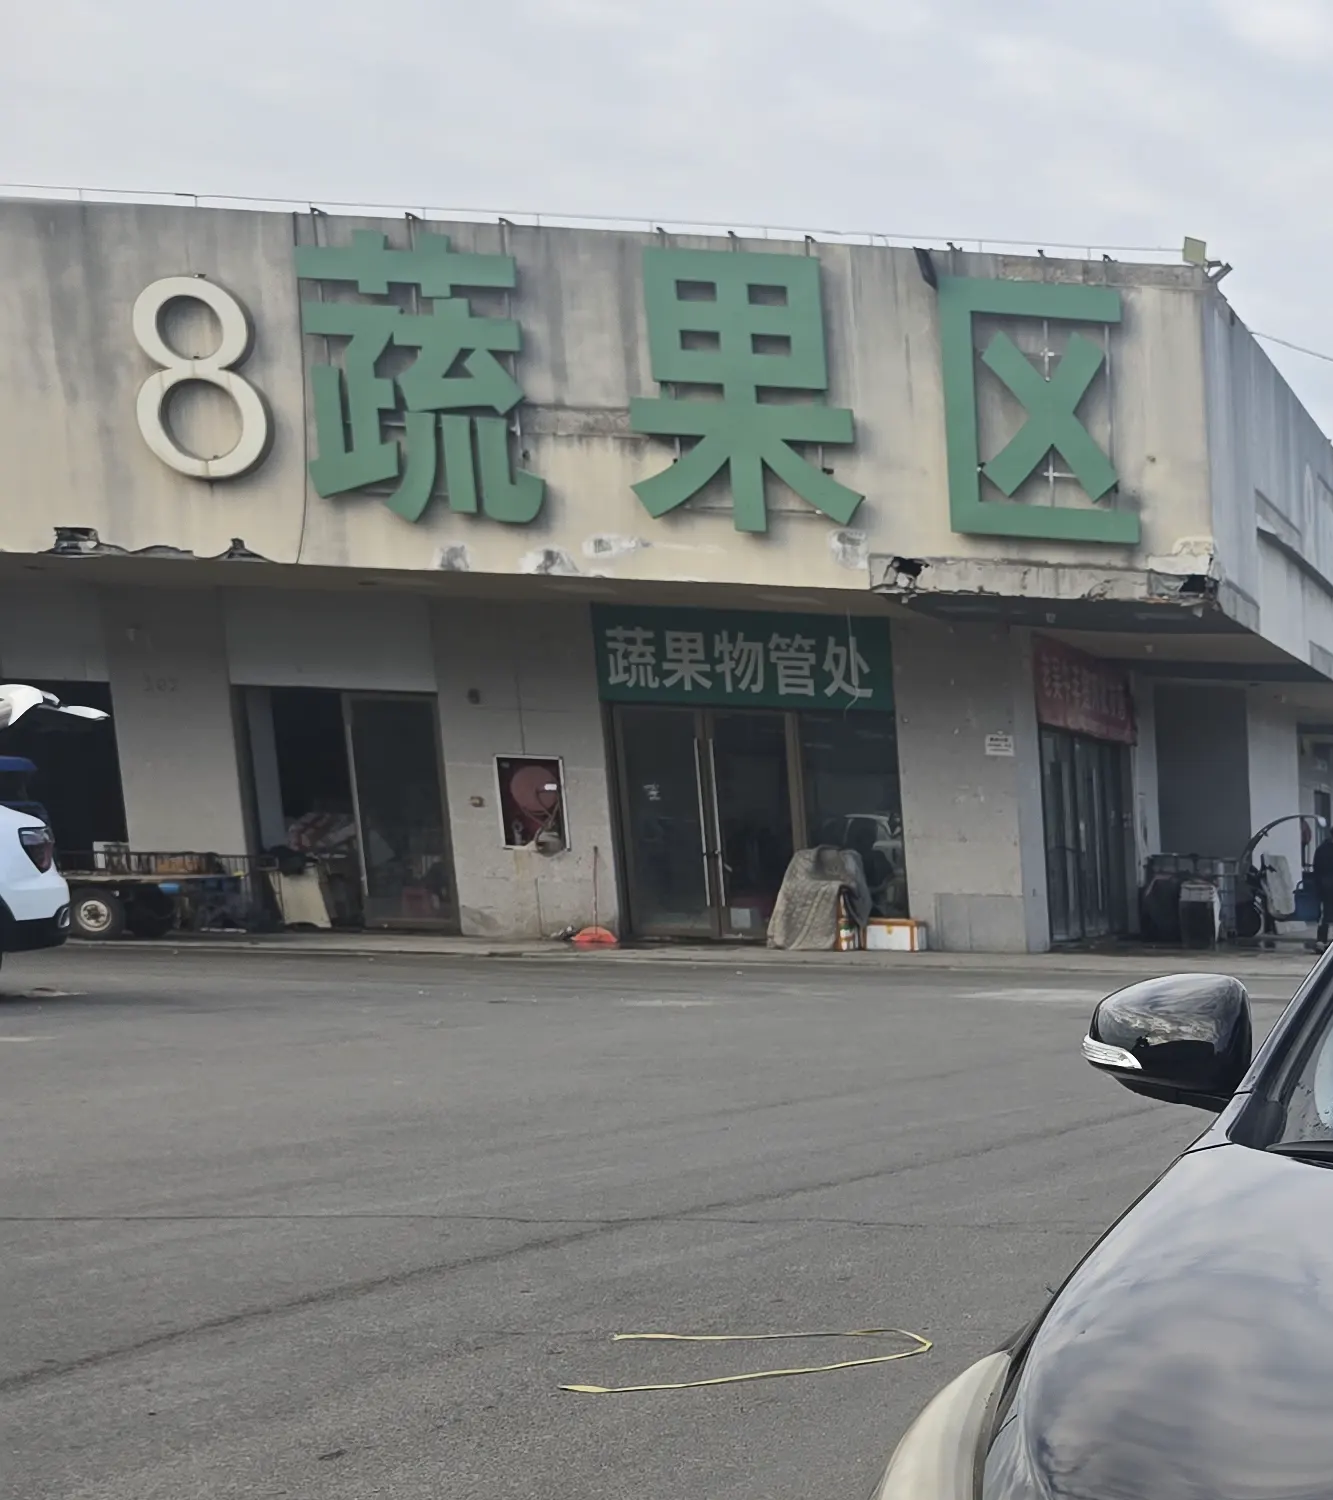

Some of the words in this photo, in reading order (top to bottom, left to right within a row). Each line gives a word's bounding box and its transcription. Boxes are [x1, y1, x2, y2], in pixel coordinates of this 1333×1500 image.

[604, 625, 874, 698] 蔬果物管处
